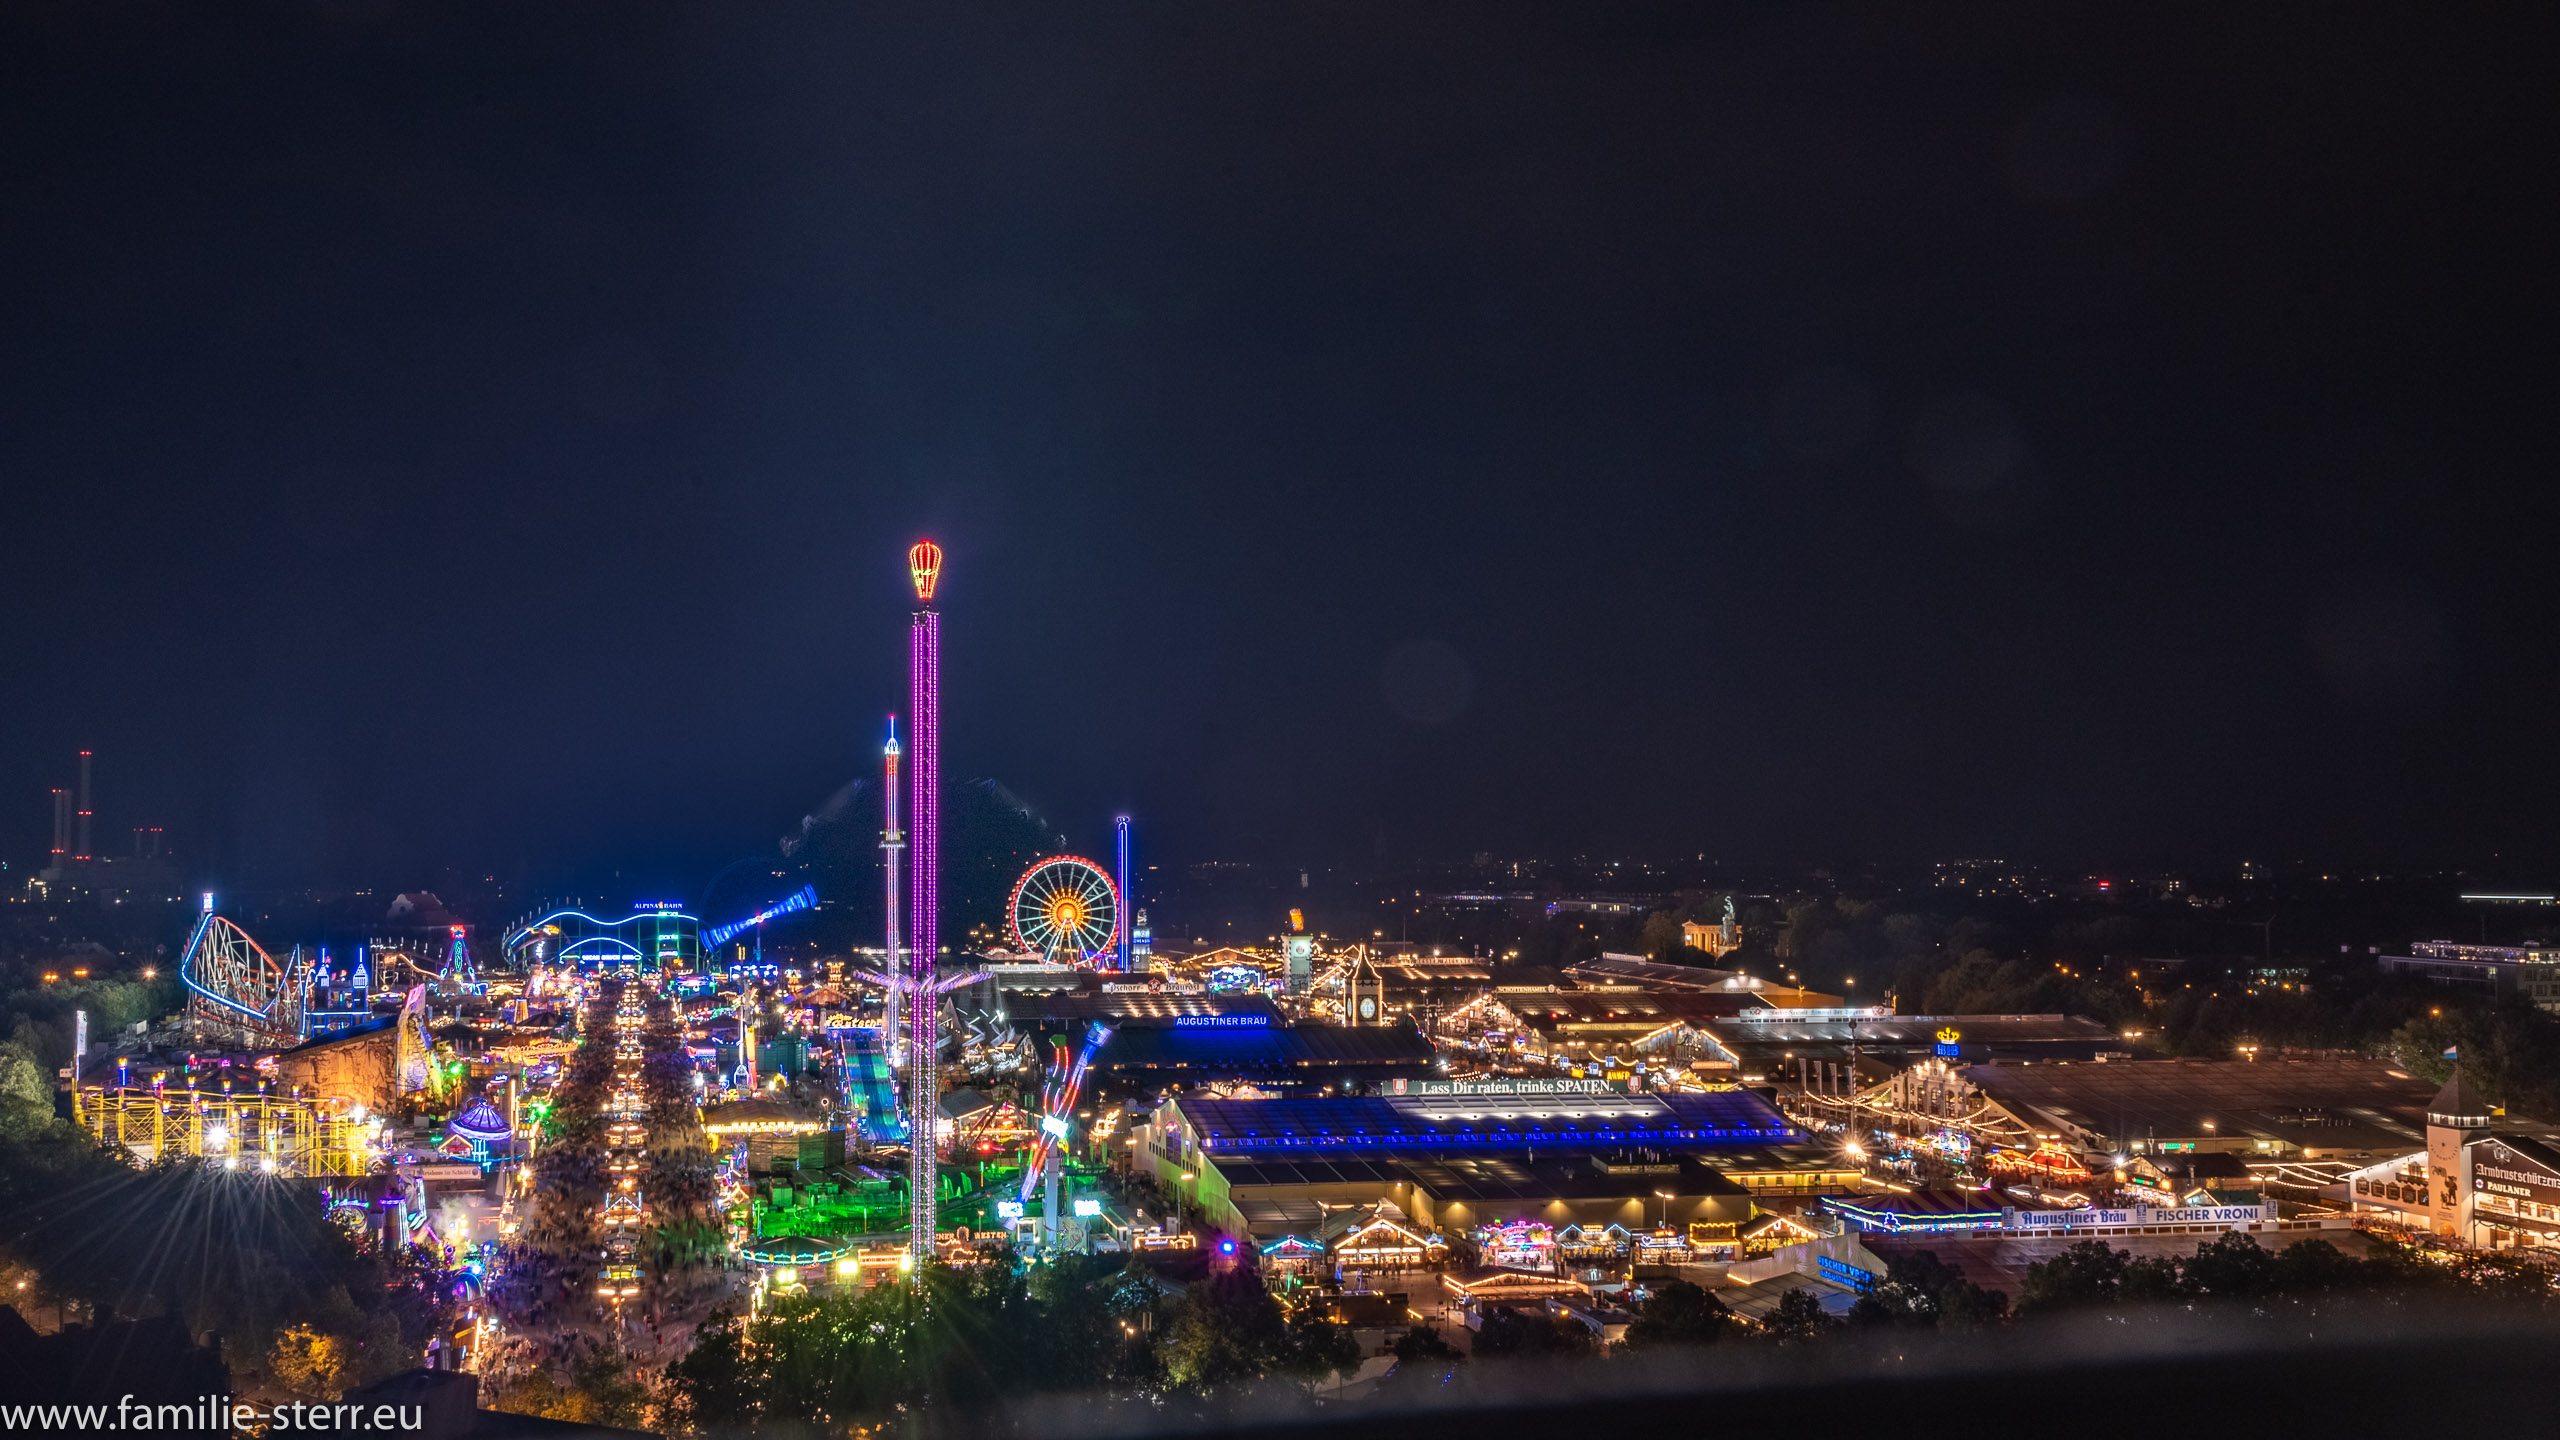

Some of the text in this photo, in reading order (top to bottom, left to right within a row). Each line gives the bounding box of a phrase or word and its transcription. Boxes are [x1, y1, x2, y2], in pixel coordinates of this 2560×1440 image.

[1176, 1015, 1267, 1026] AUGUSTINER BRÄU
[1421, 1079, 1614, 1094] Lass Dir raten, trinke SPATEN.
[2487, 1181, 2532, 1197] PAULANER
[2022, 1209, 2127, 1226] Augustiner Bräu
[2156, 1208, 2259, 1221] FISCHER VRONI
[973, 1231, 1007, 1240] WESTEN
[1817, 1255, 1848, 1275] FISCHER
